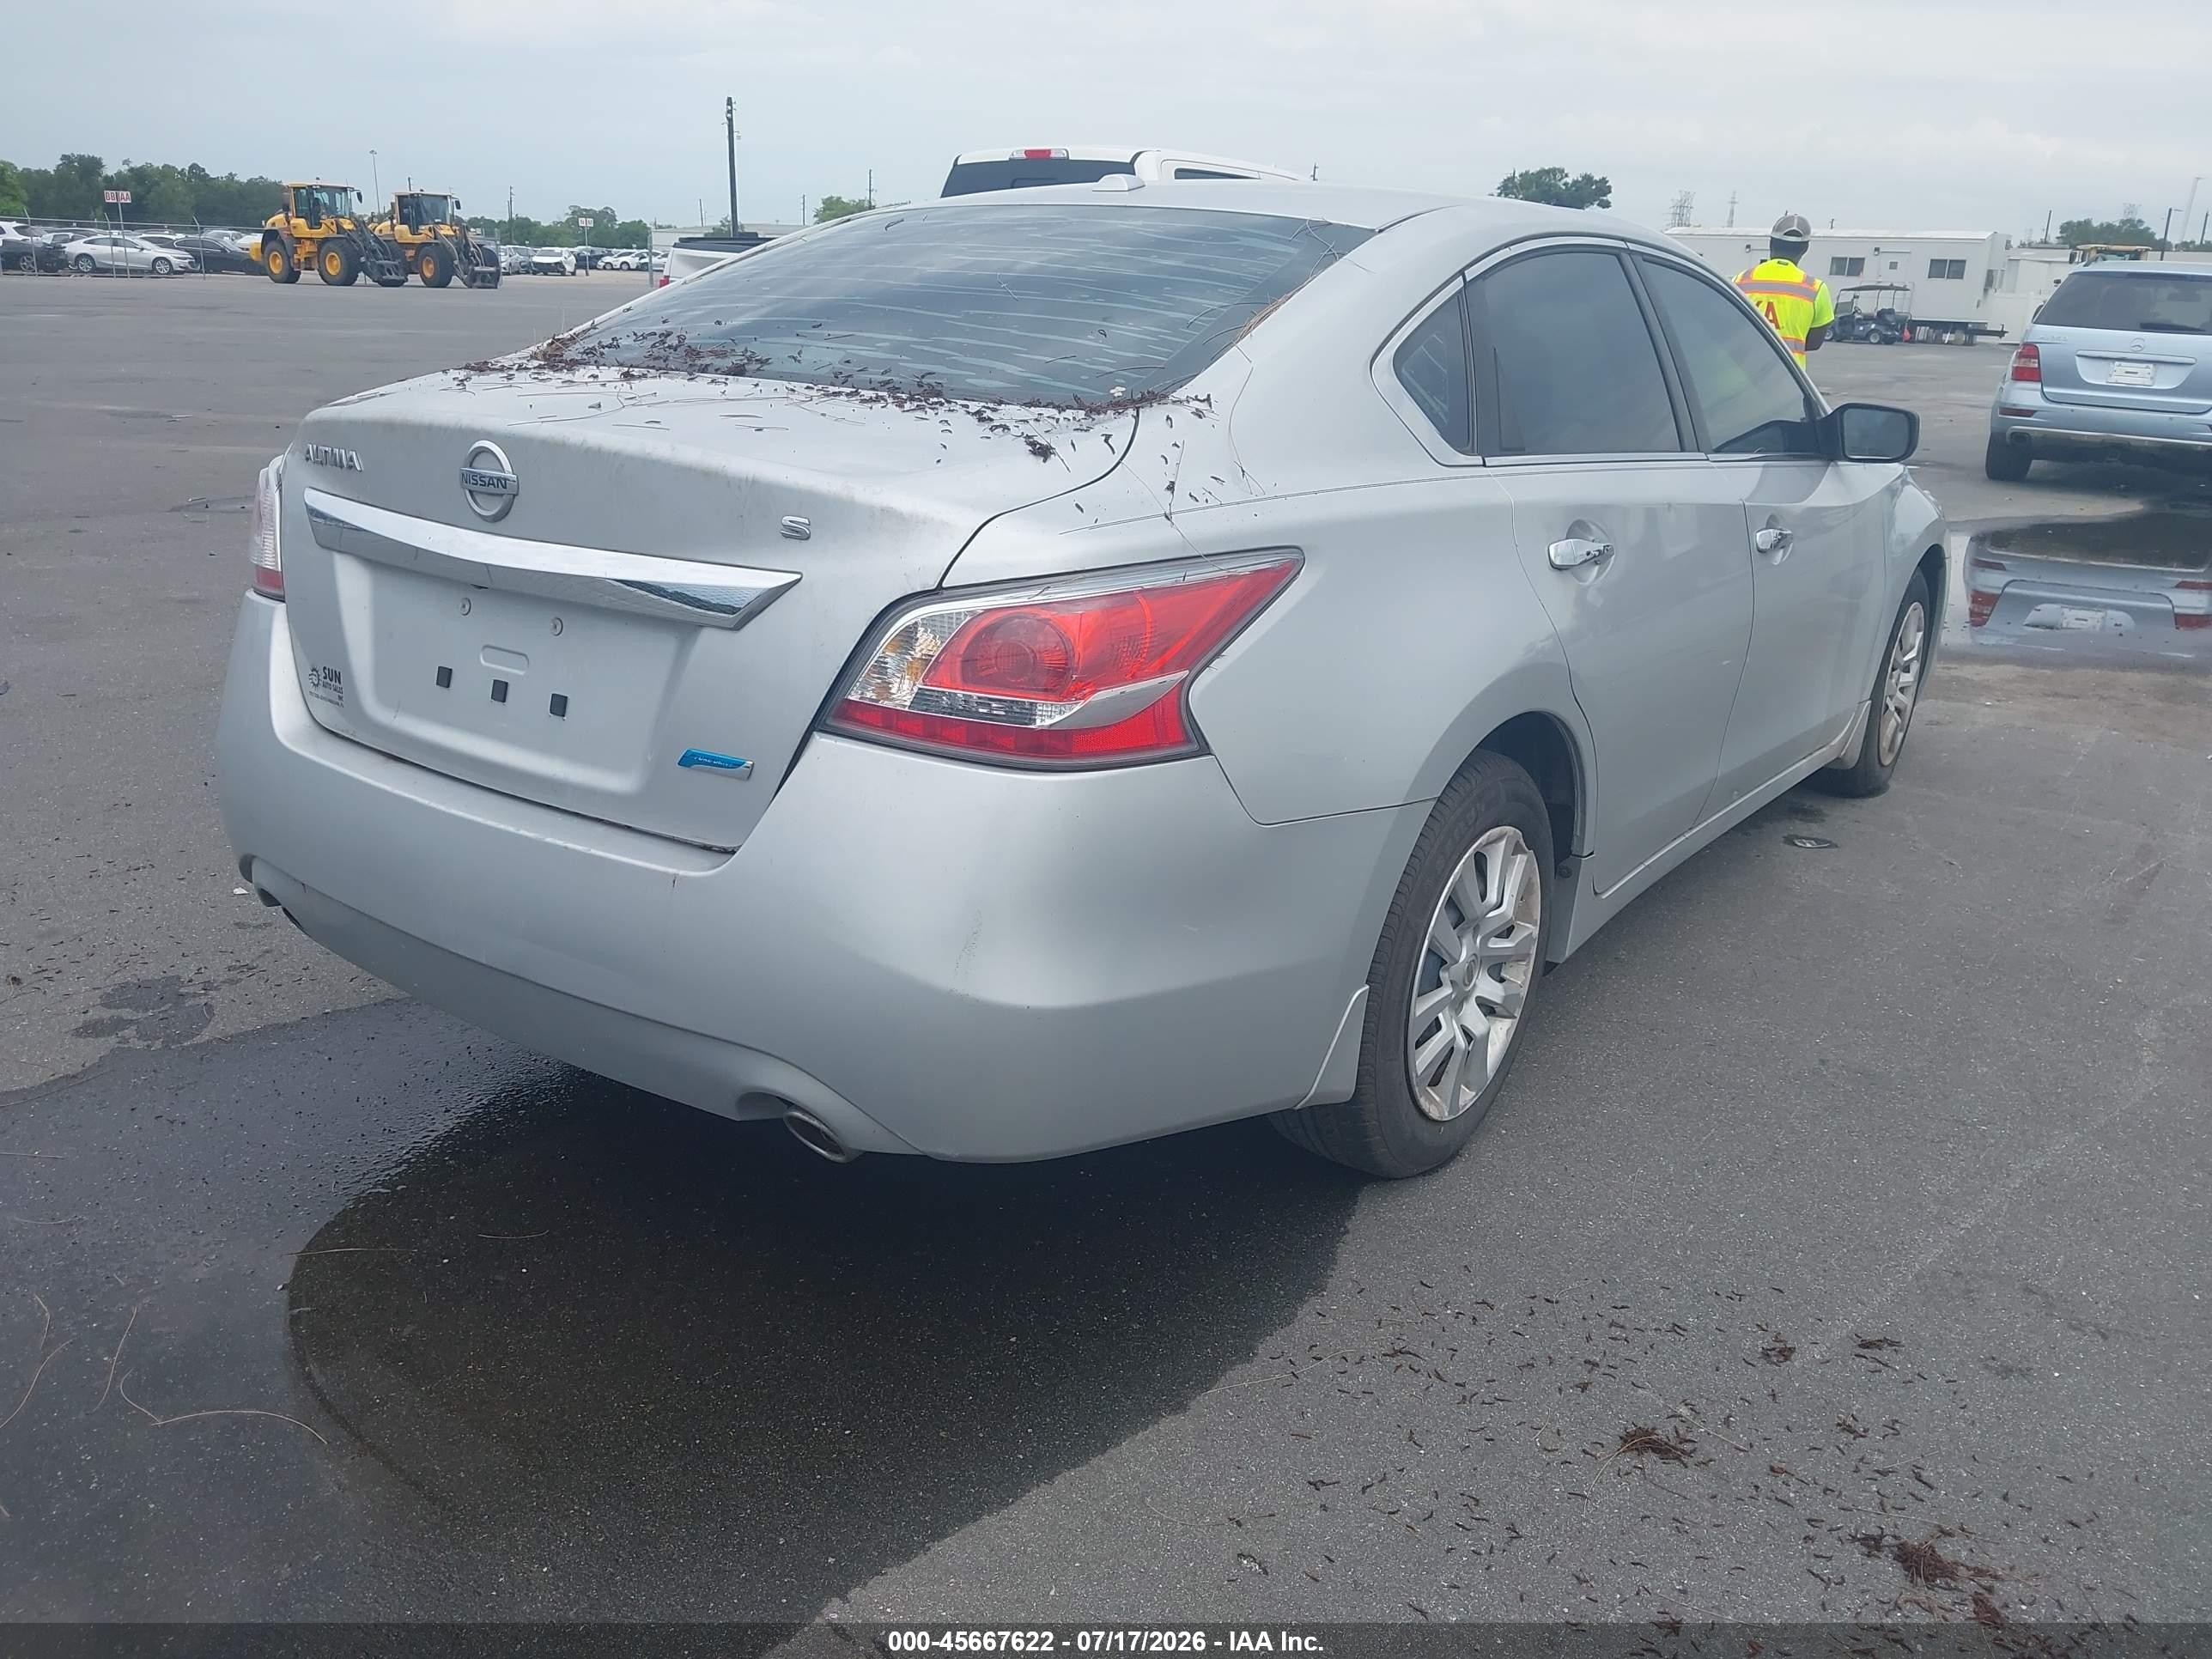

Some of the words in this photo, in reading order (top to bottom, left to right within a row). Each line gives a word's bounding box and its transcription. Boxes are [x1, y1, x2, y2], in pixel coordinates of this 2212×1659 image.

[120, 192, 131, 201] AA
[307, 443, 364, 472] ALTIMA
[461, 472, 507, 489] NISSAN
[780, 515, 811, 540] S
[322, 665, 342, 685] SUN
